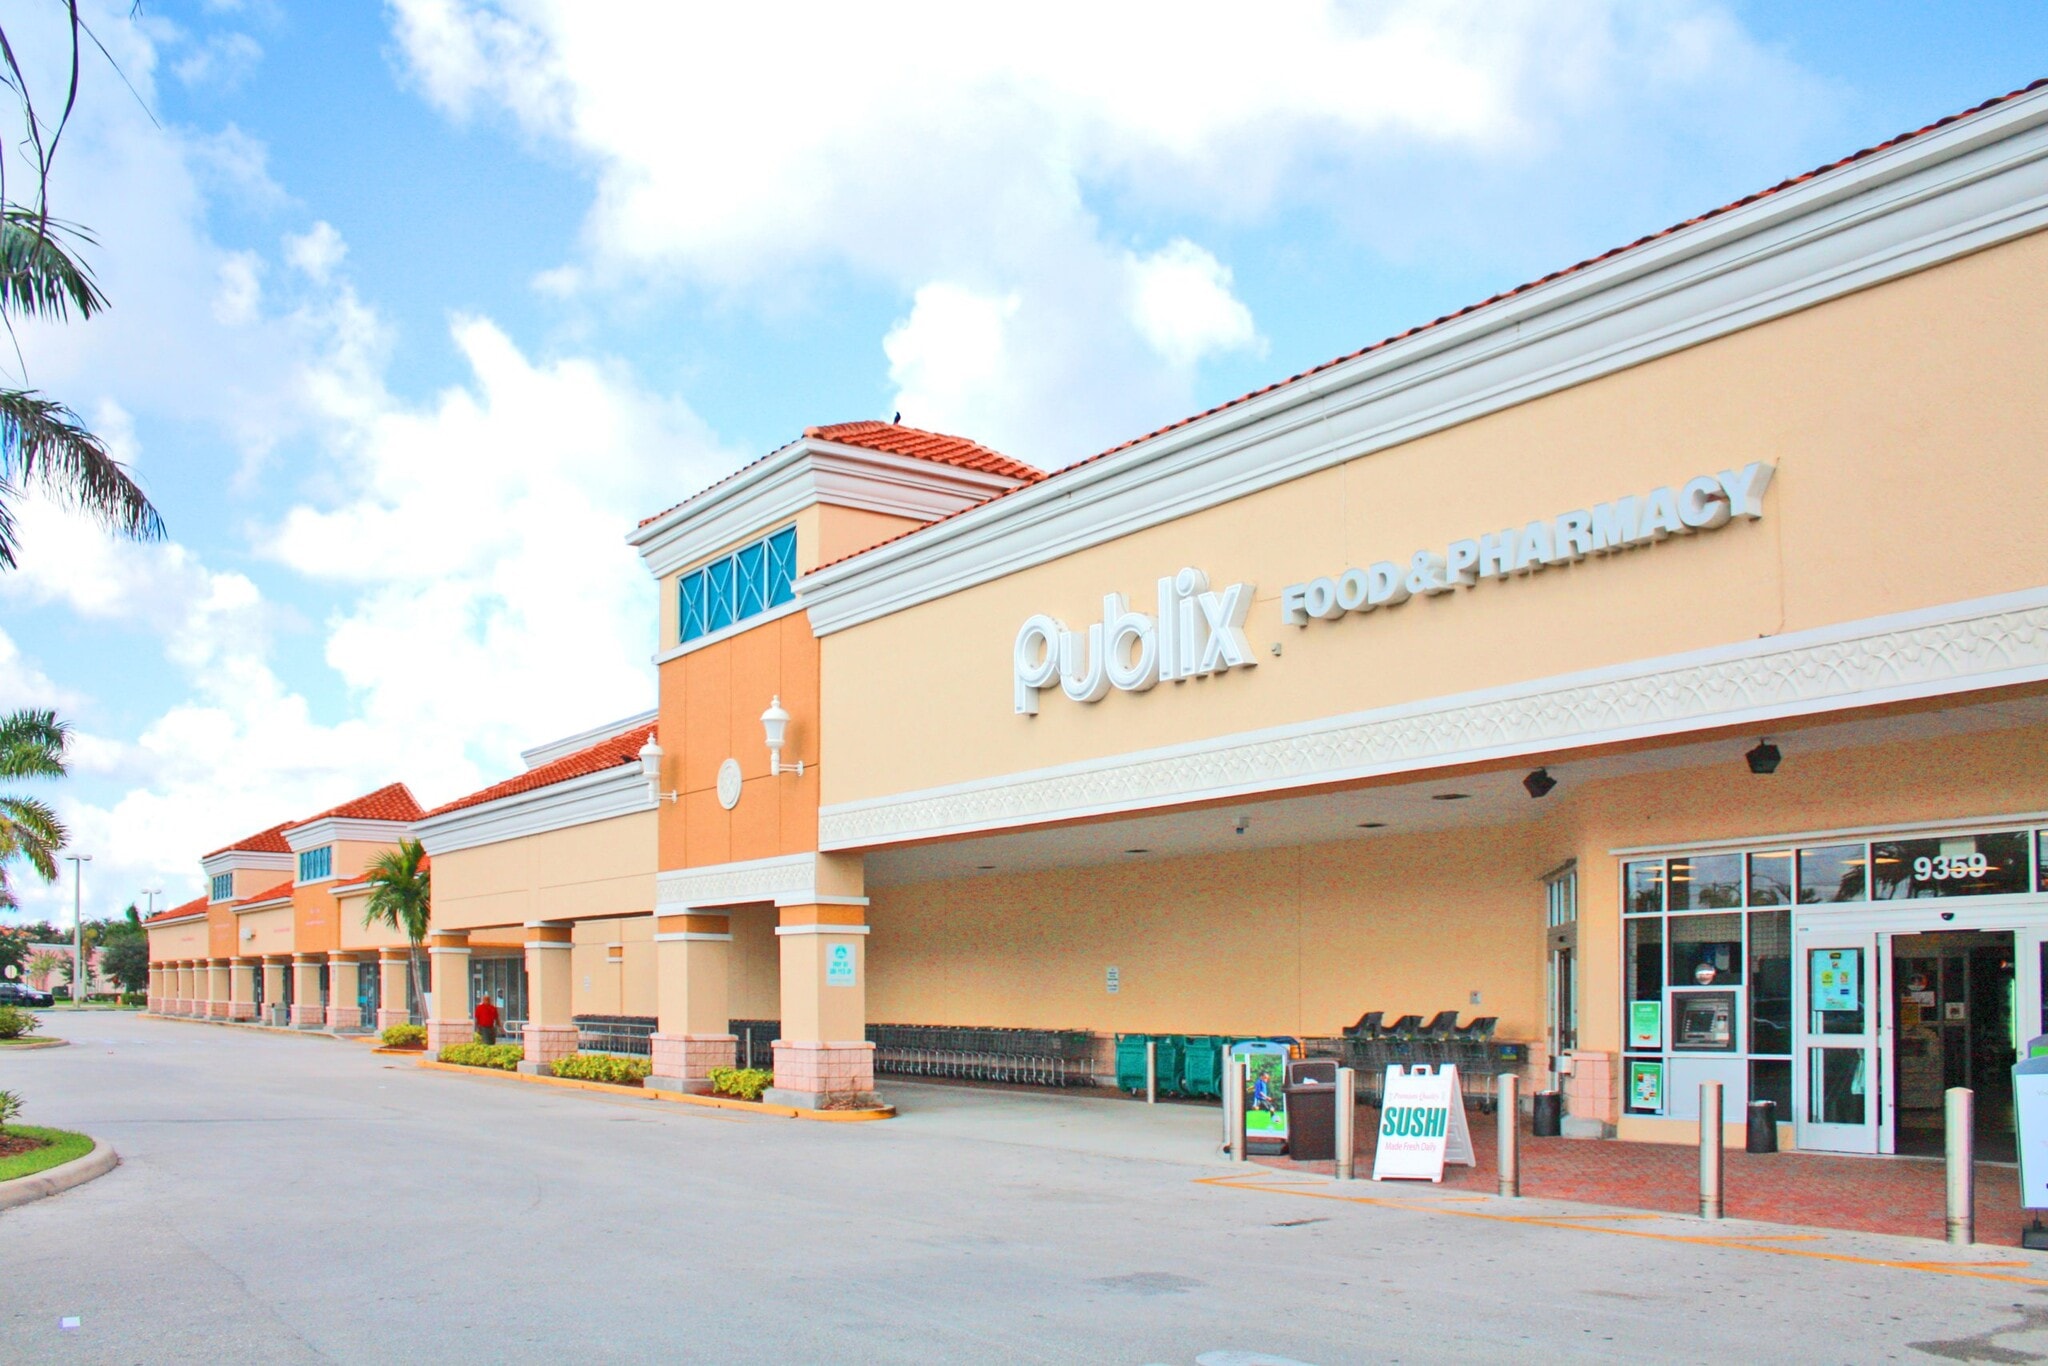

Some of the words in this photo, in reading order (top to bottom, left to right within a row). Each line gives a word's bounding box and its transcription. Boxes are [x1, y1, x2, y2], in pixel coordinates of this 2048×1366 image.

[1282, 561, 1407, 625] FOOD
[1405, 549, 1451, 596] &
[1447, 462, 1773, 586] PHARMACY
[1913, 852, 1987, 881] 9359
[1382, 1106, 1447, 1137] SUSHI
[1385, 1141, 1402, 1151] Made
[1403, 1141, 1419, 1151] Fresh
[1420, 1142, 1437, 1153] Daily
